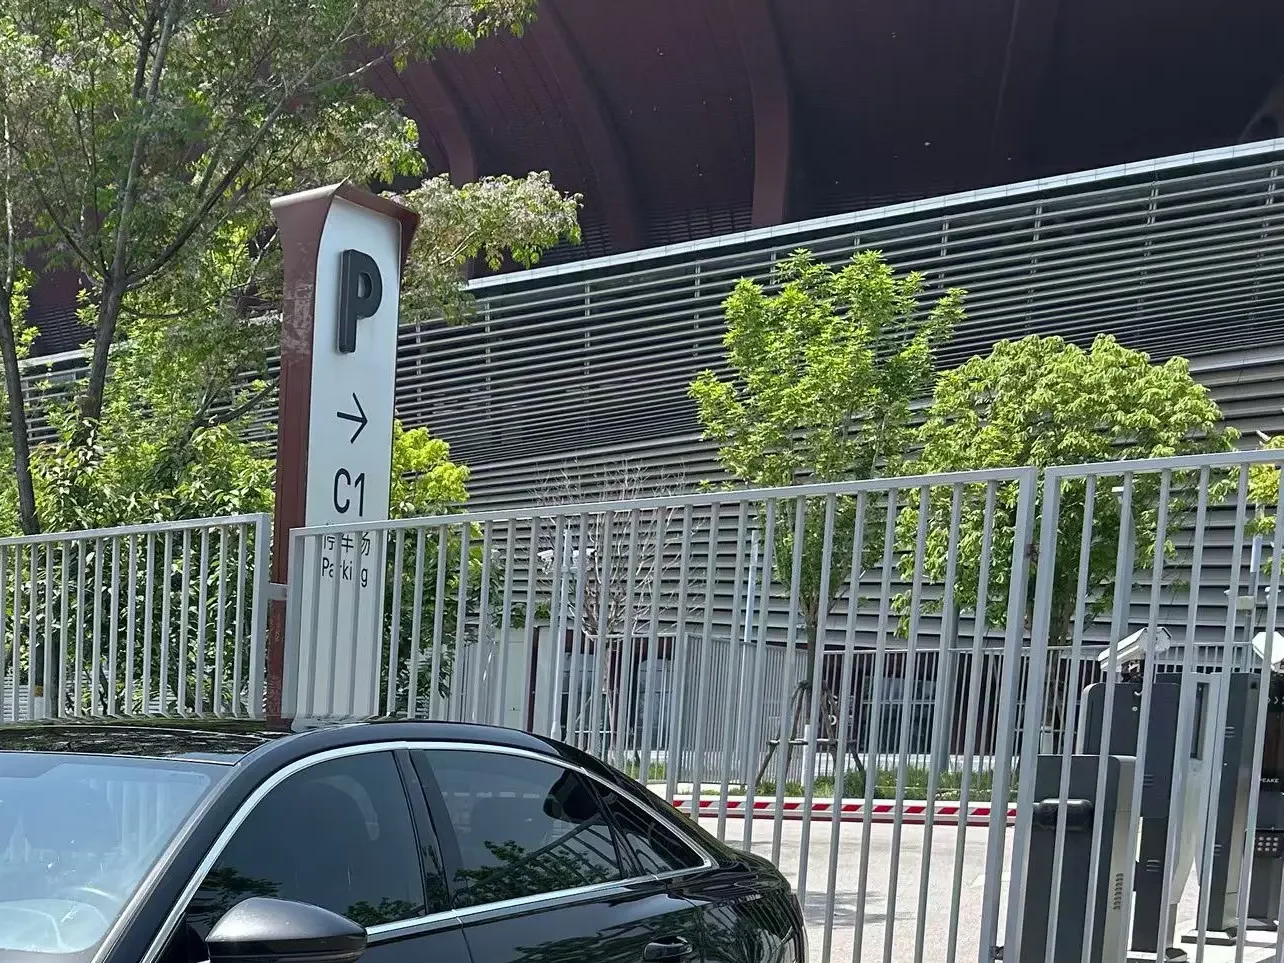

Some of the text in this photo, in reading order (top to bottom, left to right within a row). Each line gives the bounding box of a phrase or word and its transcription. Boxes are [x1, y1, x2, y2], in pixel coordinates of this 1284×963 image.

[338, 249, 383, 354] P
[333, 467, 365, 517] C1
[321, 557, 369, 588] Pakig
